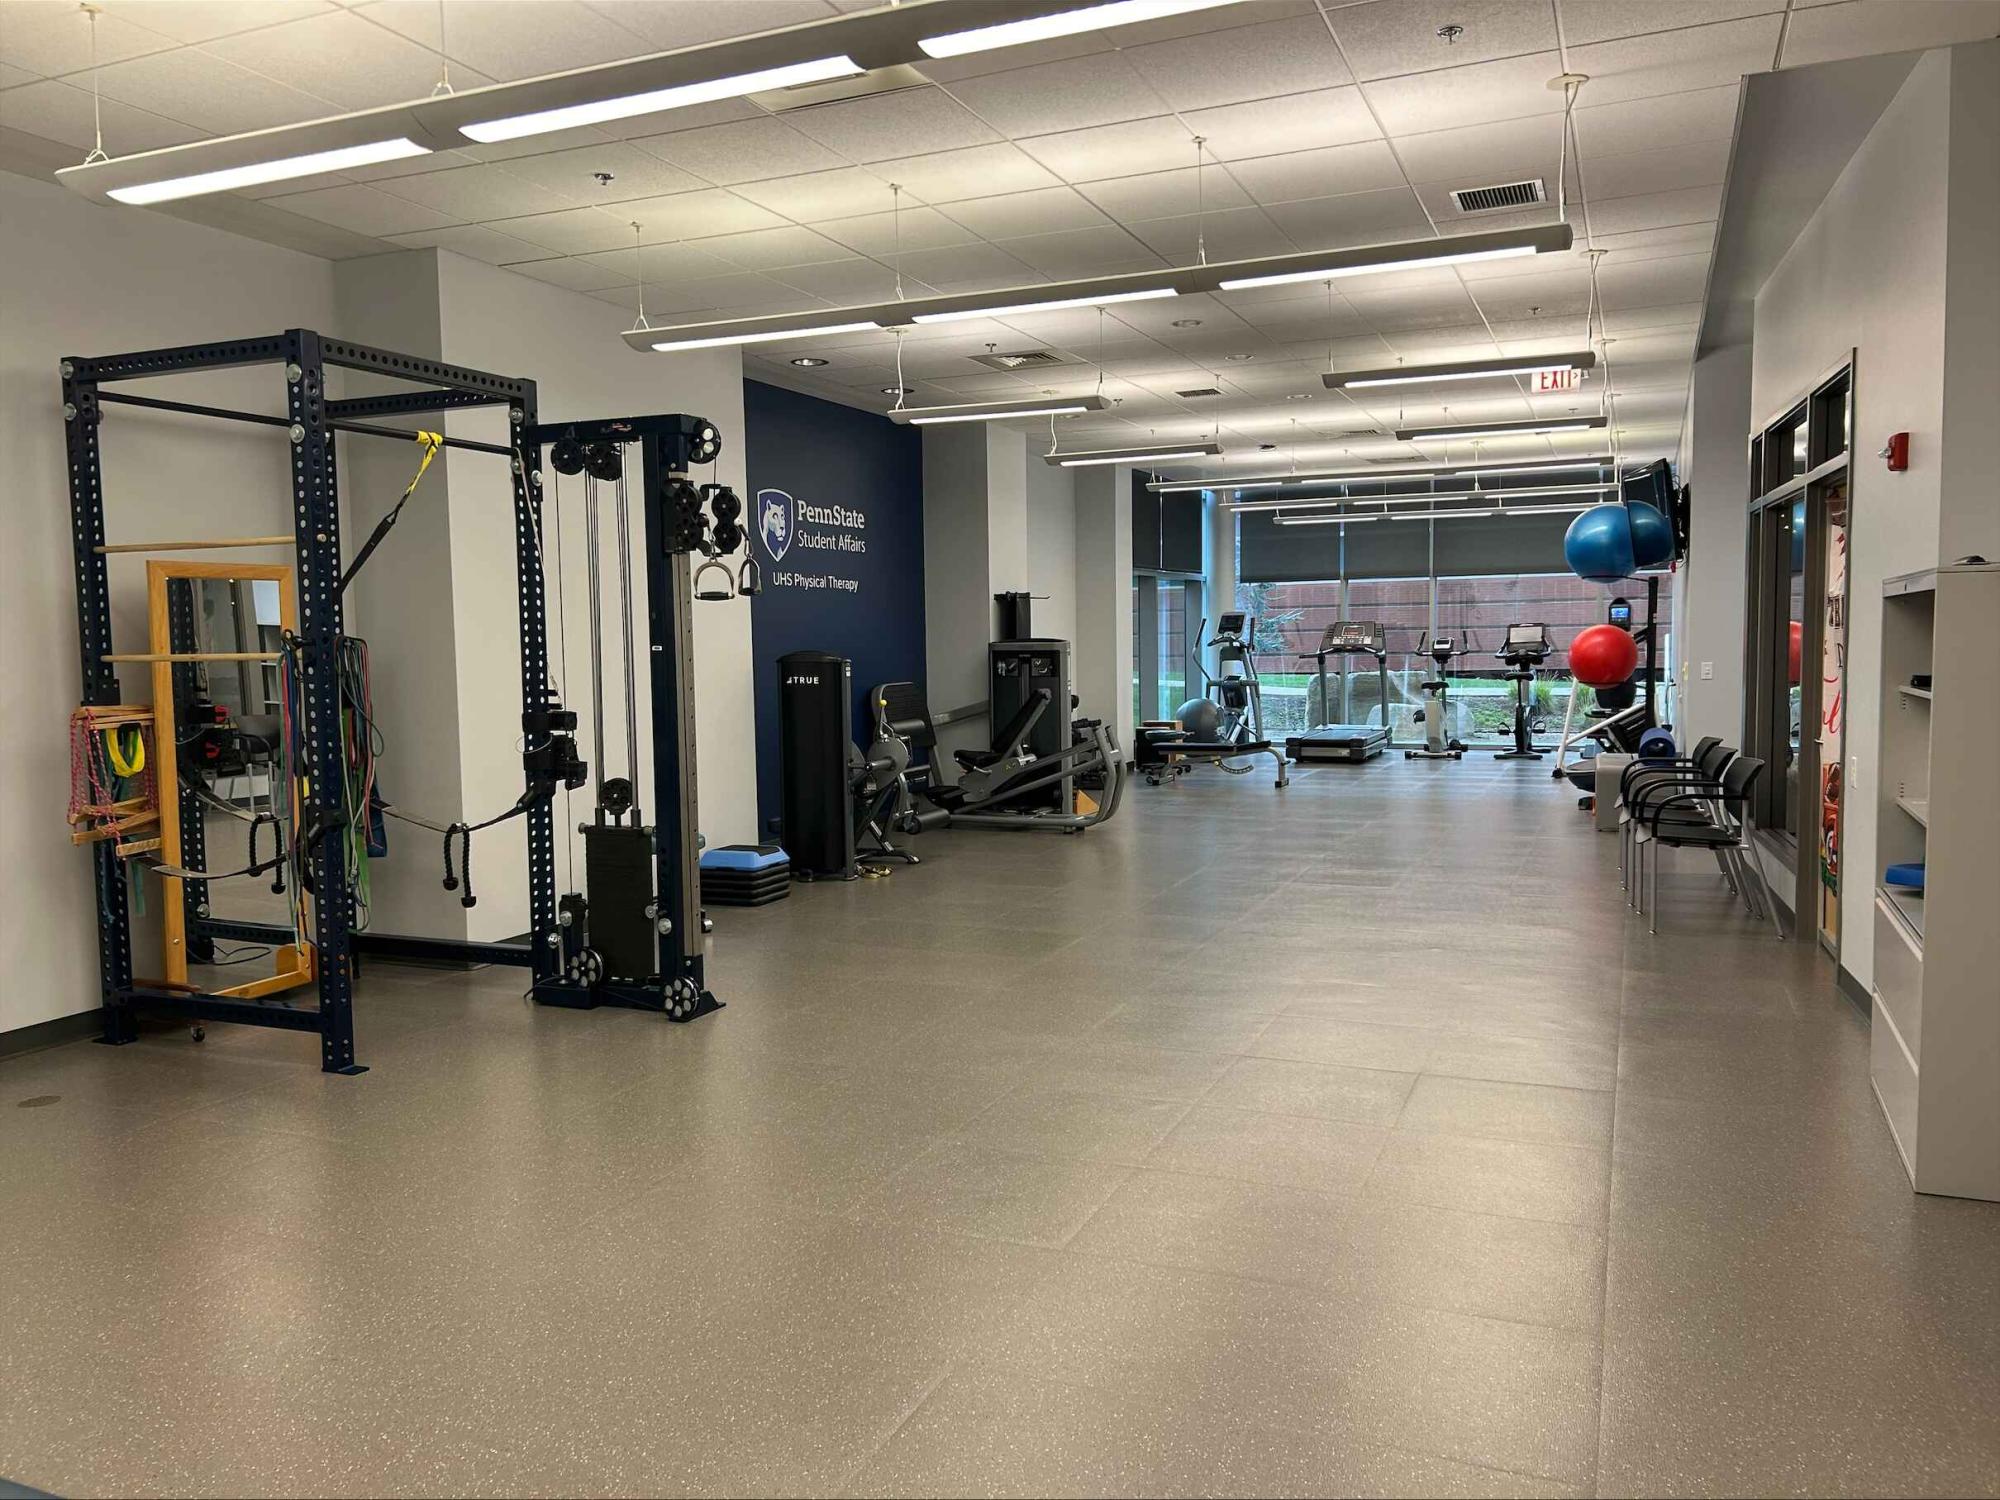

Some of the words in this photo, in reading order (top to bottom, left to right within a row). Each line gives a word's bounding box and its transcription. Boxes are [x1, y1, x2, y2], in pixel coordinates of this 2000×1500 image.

[797, 500, 865, 529] PennState
[798, 529, 836, 551] Student
[838, 534, 866, 553] Affairs
[773, 571, 793, 586] UHS
[794, 573, 827, 590] Physical
[828, 575, 859, 593] Therapy
[793, 676, 820, 685] TRUE
